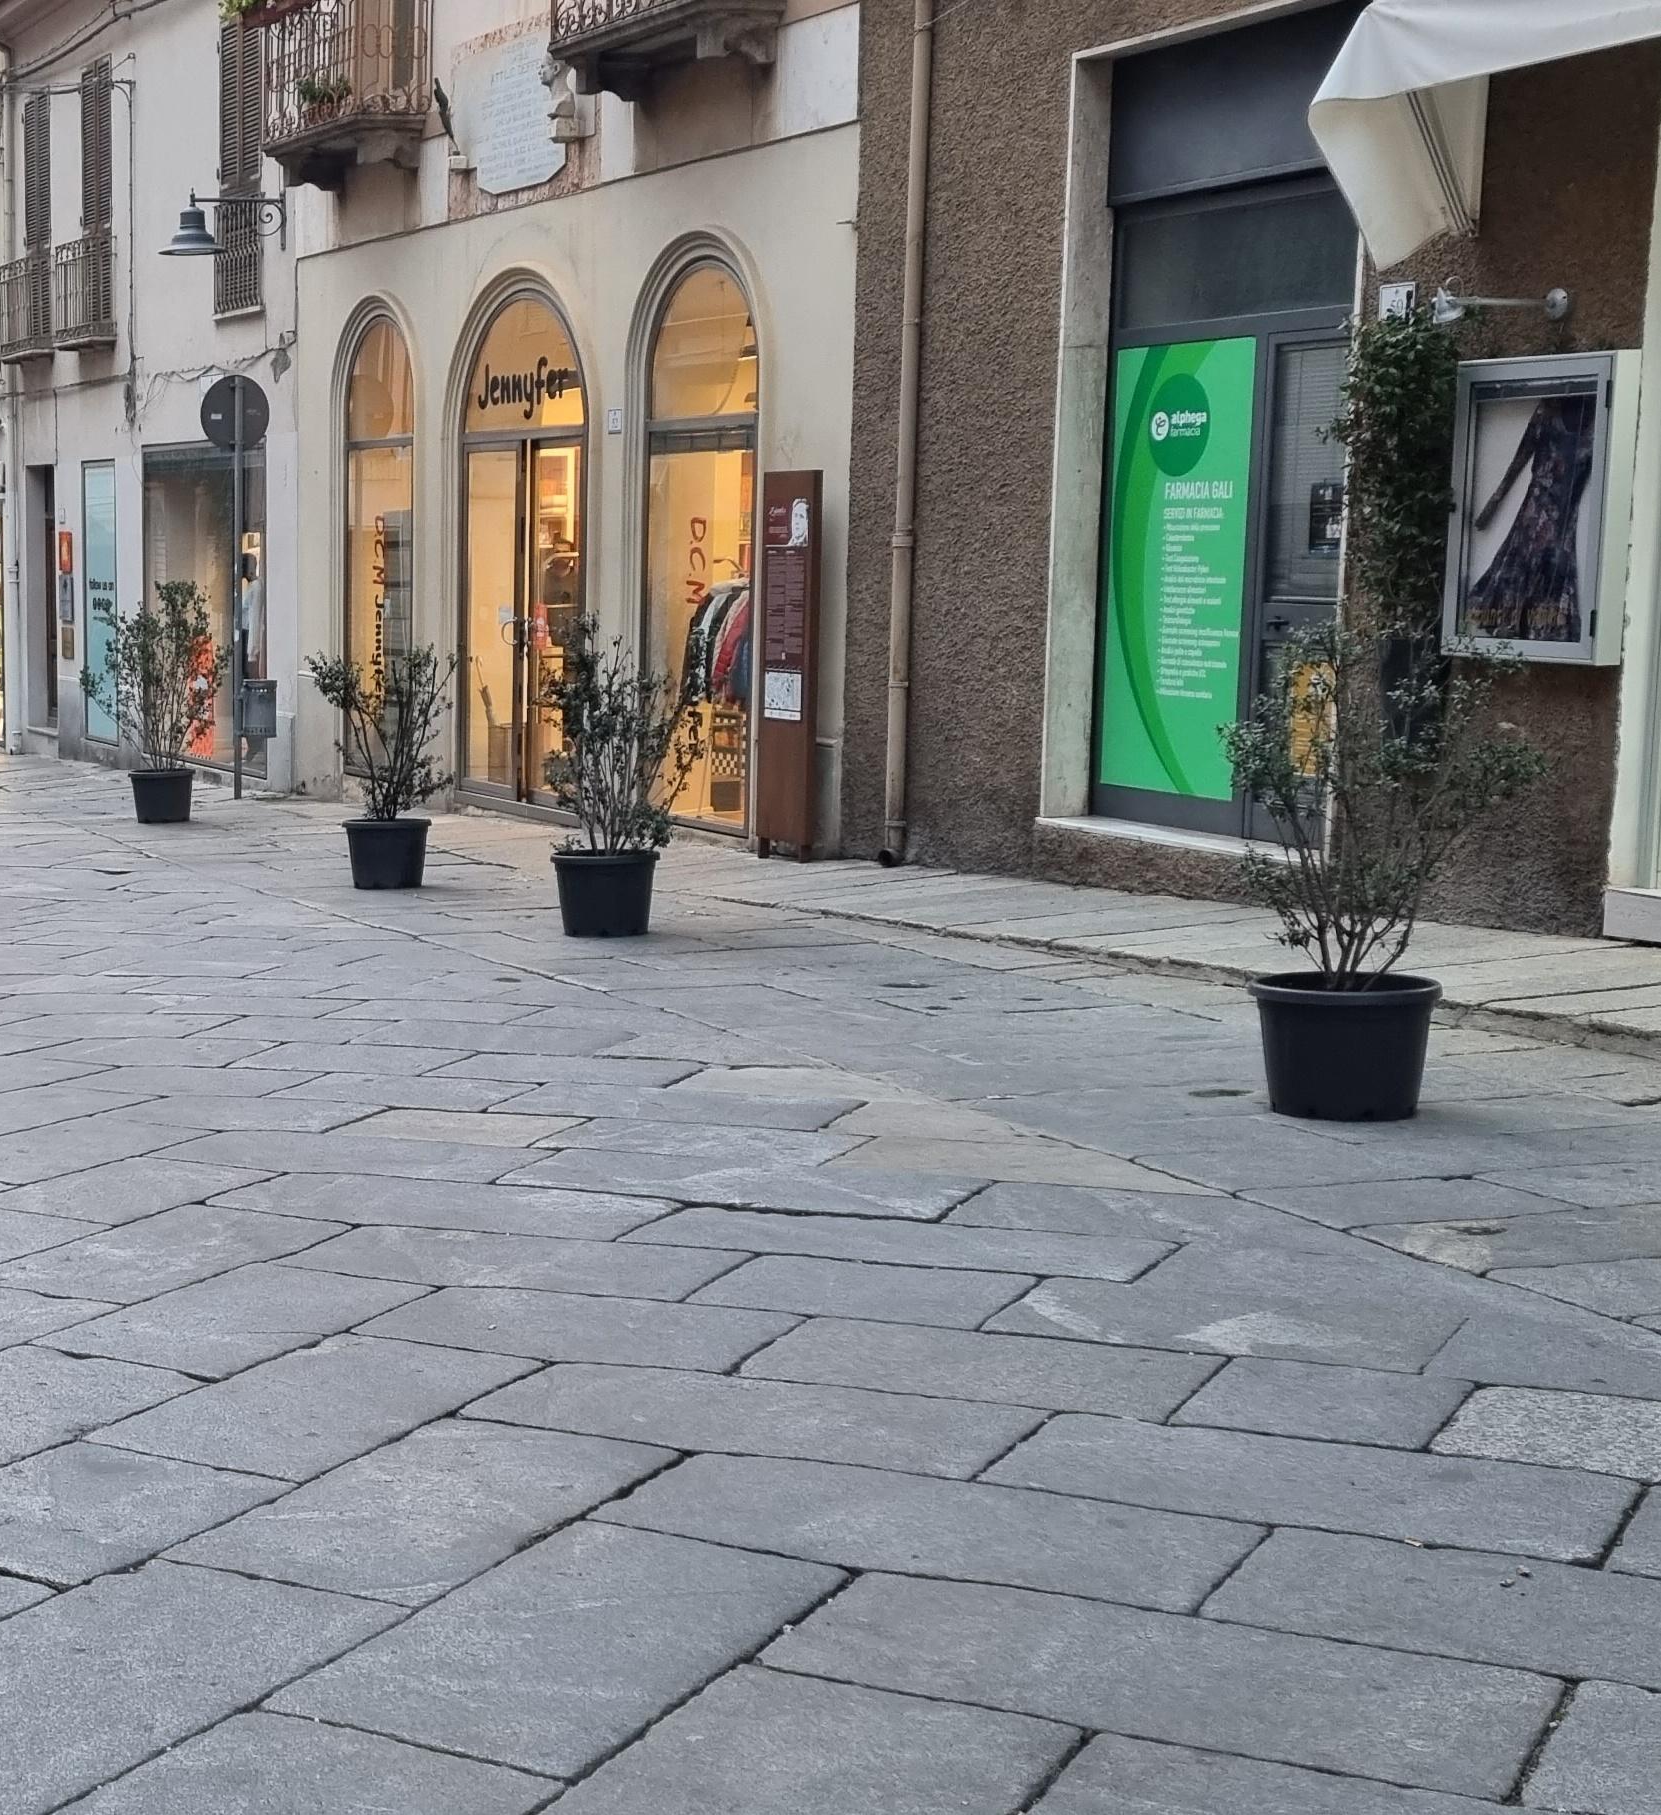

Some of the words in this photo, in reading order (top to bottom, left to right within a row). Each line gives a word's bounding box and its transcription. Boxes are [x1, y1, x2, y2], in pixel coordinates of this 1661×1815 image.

[478, 356, 569, 419] Jennyfer
[1170, 411, 1207, 426] alphega
[1170, 425, 1201, 437] farmacia
[1165, 481, 1210, 501] FARMACIA
